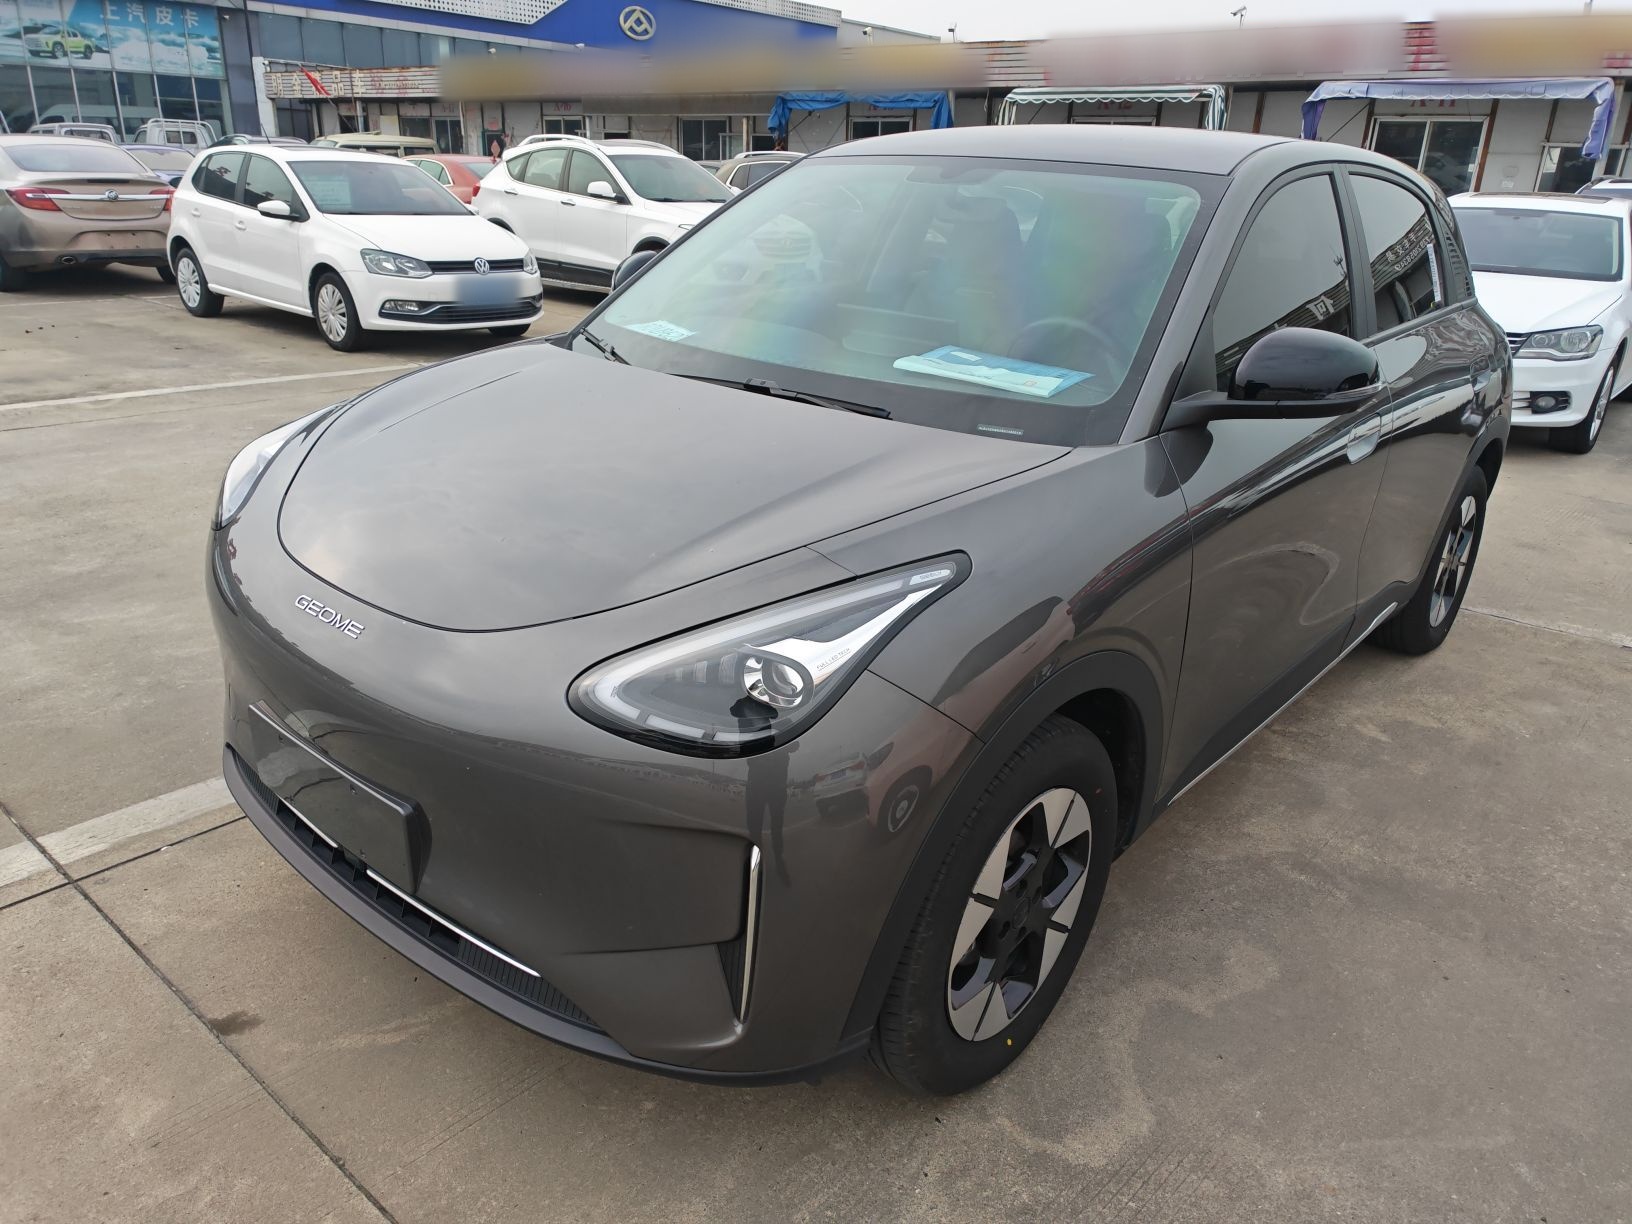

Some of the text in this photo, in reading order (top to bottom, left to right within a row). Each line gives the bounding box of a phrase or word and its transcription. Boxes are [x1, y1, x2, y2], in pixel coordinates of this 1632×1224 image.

[99, 2, 200, 29] 上汽皮卡
[271, 69, 368, 98] 明金品车
[294, 594, 366, 639] GEOME
